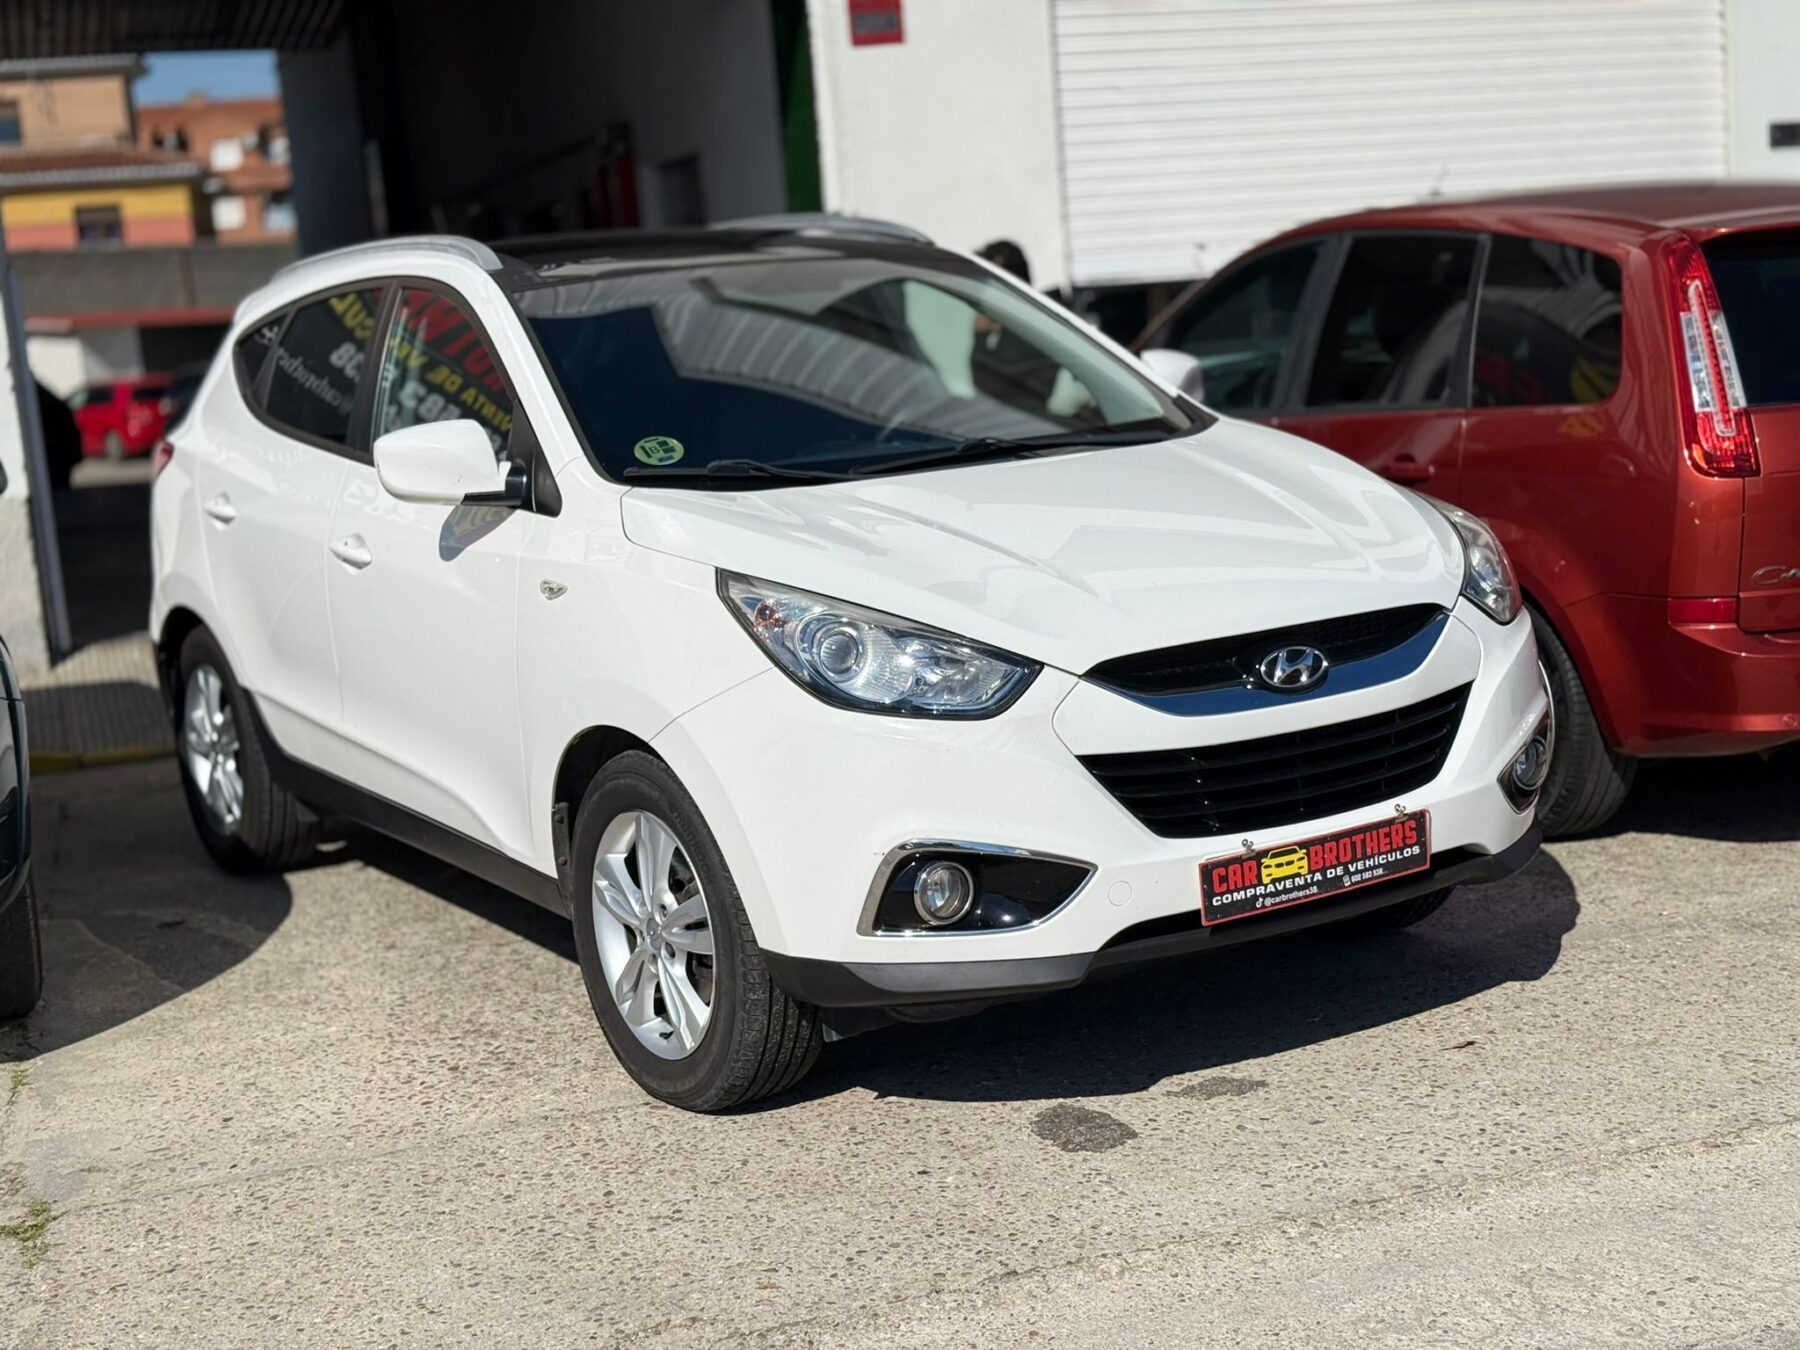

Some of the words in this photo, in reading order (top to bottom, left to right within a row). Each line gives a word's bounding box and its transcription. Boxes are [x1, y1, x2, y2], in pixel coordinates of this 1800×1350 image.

[1212, 860, 1259, 893] CAR
[1310, 819, 1417, 870] BROTHERS
[1212, 872, 1322, 906] COMPRAVENTA
[1326, 866, 1344, 878] DE
[1348, 845, 1421, 872] VEHÍCULOS
